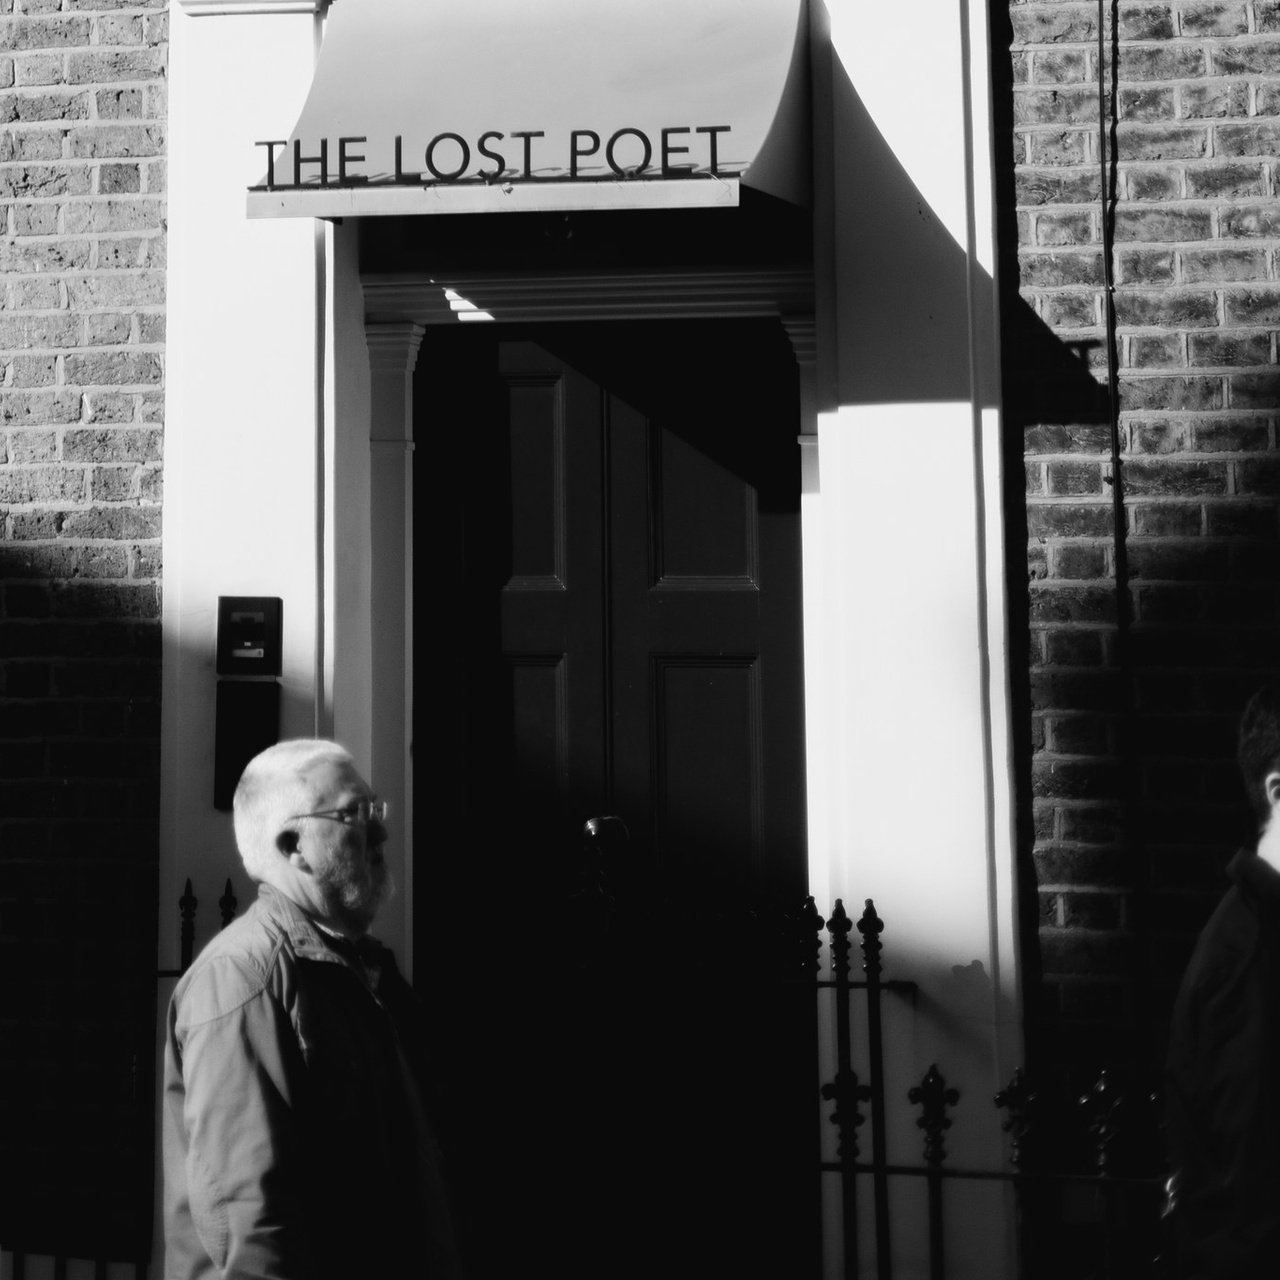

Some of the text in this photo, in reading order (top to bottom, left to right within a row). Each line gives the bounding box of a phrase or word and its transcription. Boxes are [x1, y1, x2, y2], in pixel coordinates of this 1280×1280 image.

[255, 125, 731, 187] THE LOST POET
